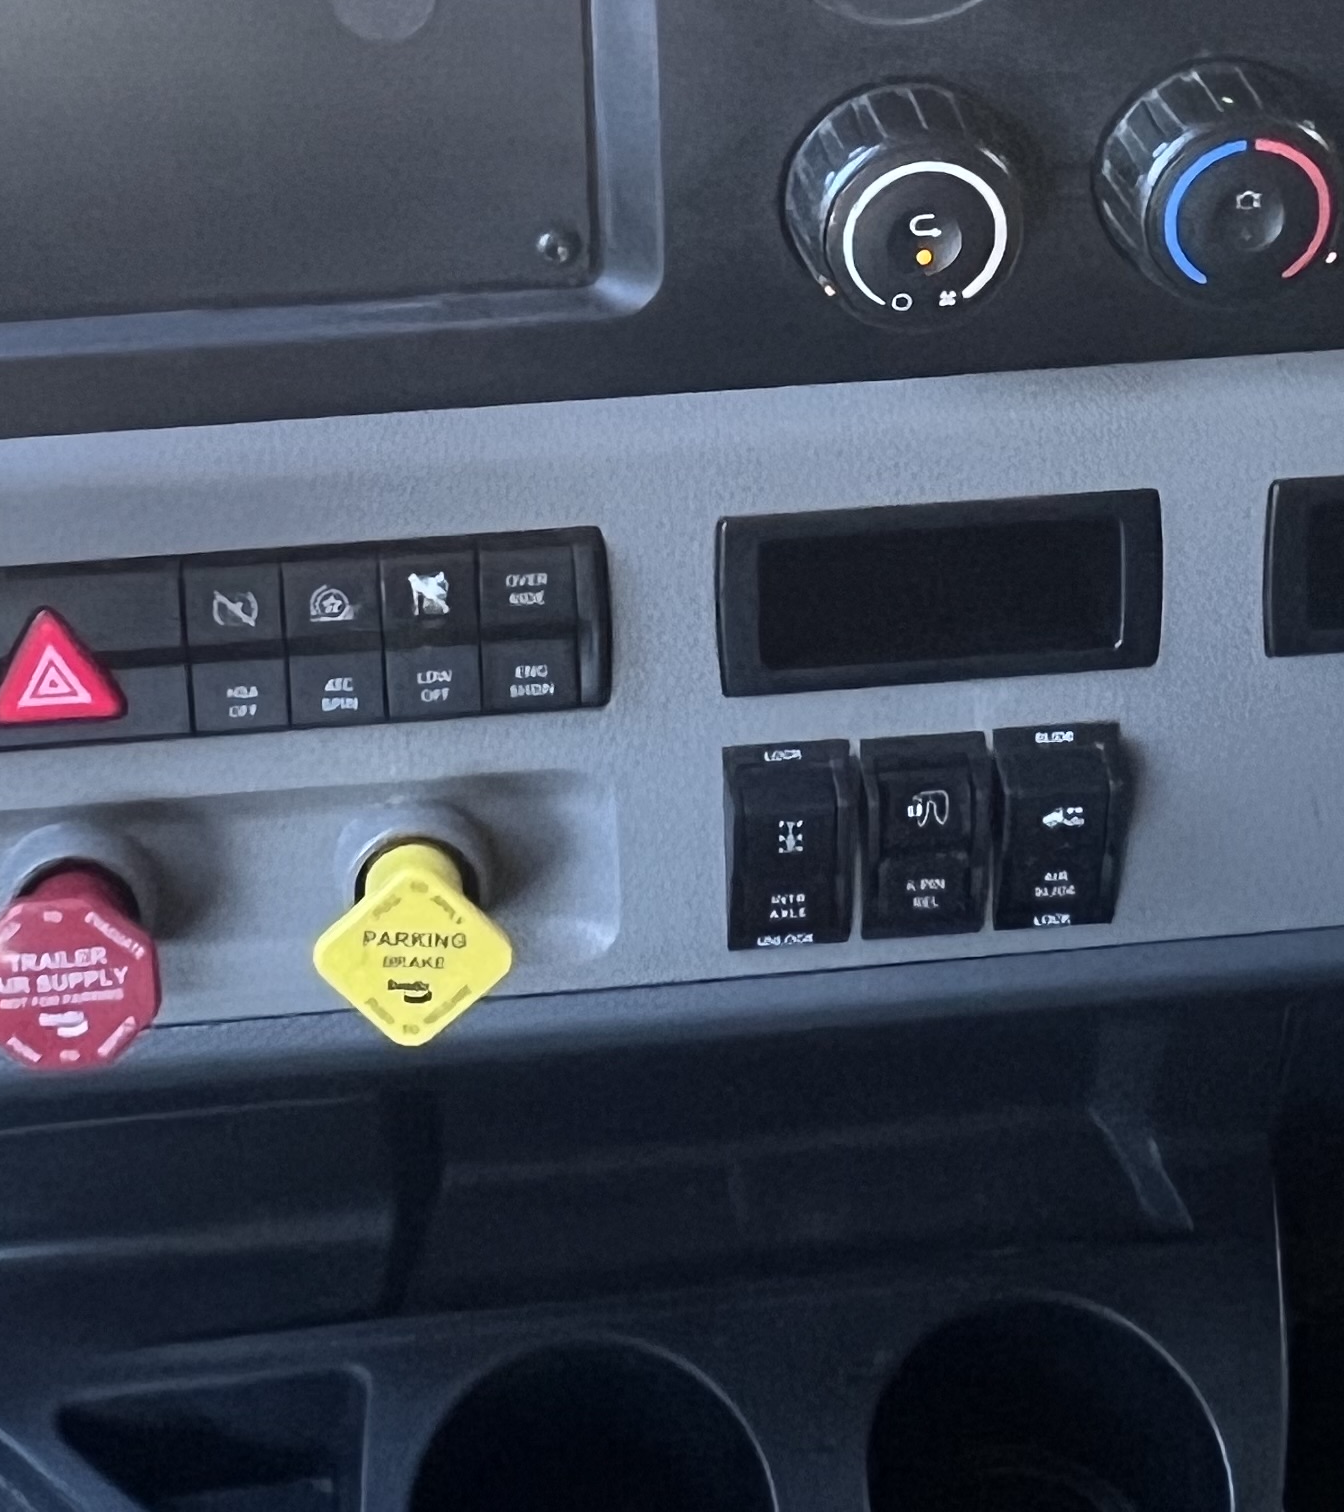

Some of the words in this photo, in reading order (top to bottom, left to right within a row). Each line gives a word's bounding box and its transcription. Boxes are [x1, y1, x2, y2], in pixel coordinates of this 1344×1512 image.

[363, 930, 467, 949] PARKING
[6, 946, 108, 973] TRAILER
[382, 955, 445, 970] BRAKE
[37, 966, 128, 994] SUPPLY
